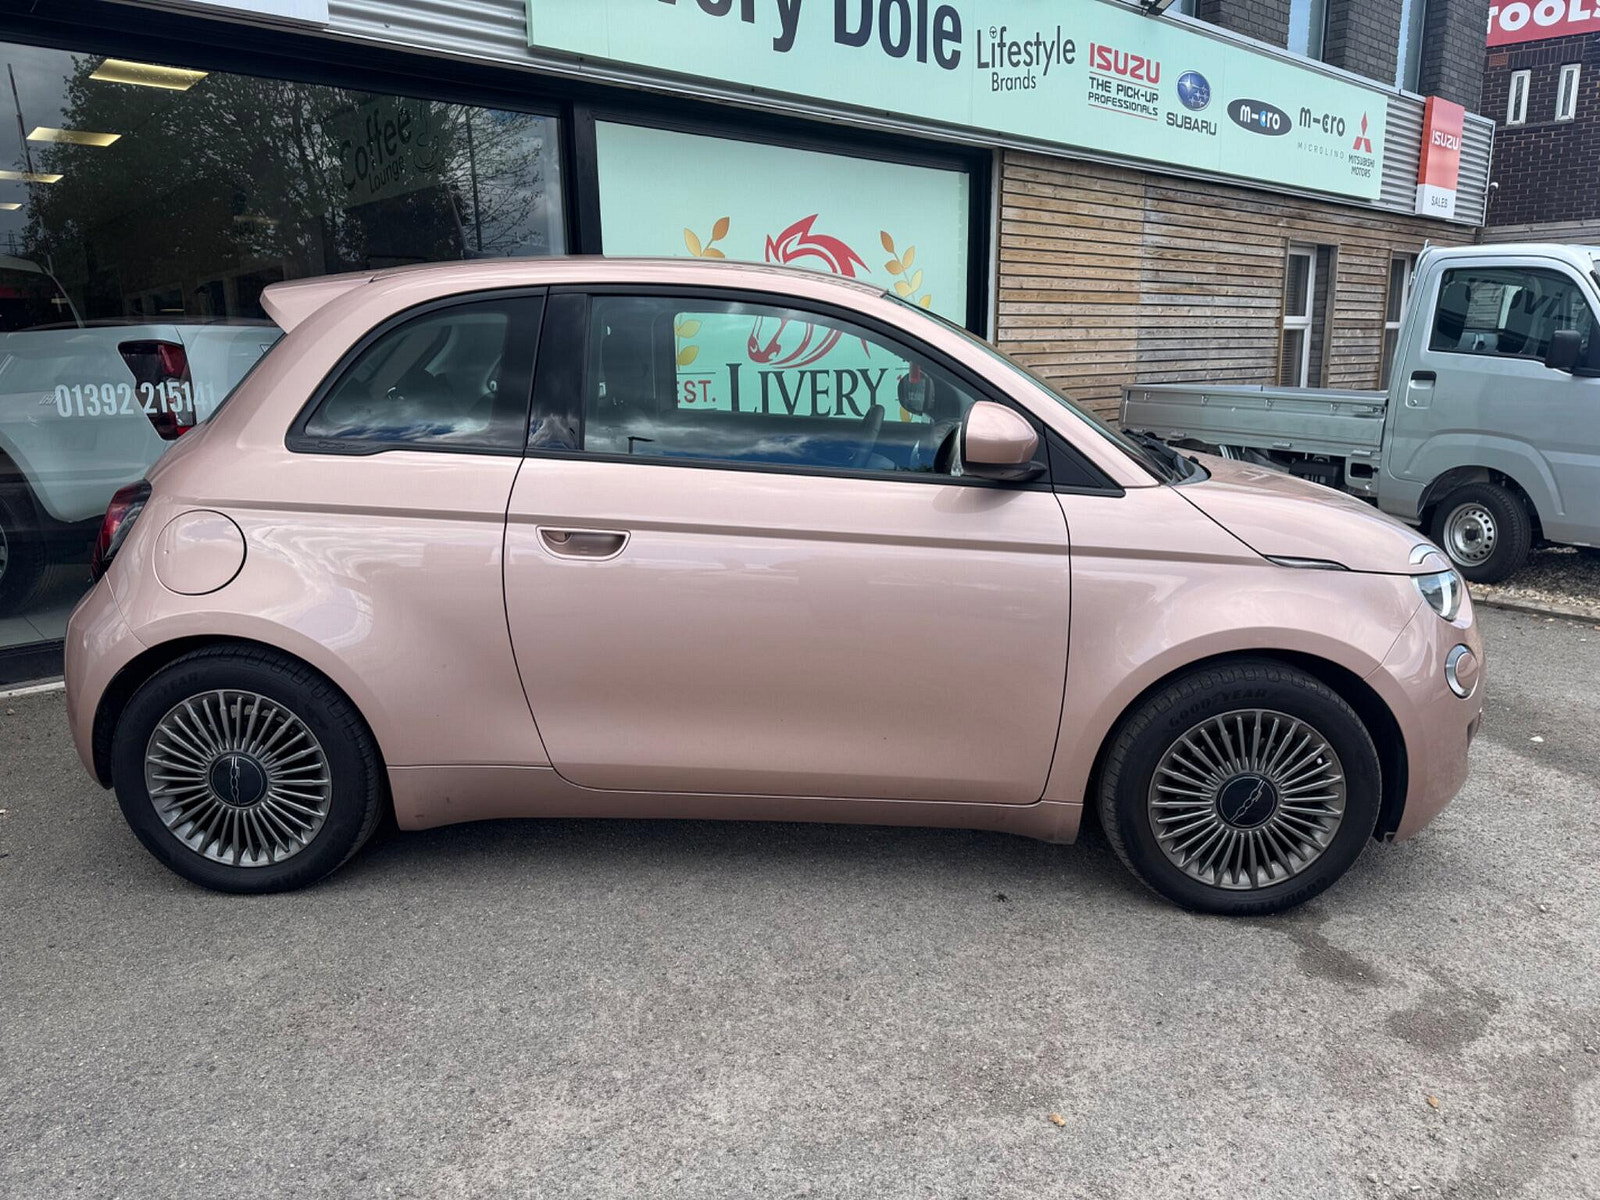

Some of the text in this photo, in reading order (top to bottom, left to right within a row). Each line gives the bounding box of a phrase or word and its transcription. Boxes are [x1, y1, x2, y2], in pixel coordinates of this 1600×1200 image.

[833, 0, 963, 71] Dole
[976, 25, 1077, 77] Lifestyle
[1089, 42, 1161, 84] ISUZU
[991, 69, 1037, 92] Brands
[1089, 77, 1159, 105] THE PICK-UP
[1088, 92, 1158, 117] PROFESSIONALS
[1166, 112, 1217, 137] SUBARU
[1298, 142, 1345, 160] MICROLINO
[1432, 130, 1460, 151] ISUZU
[1350, 166, 1371, 178] MOTORS
[54, 381, 216, 418] 01392 215141
[676, 363, 889, 417] ST. LIVERY
